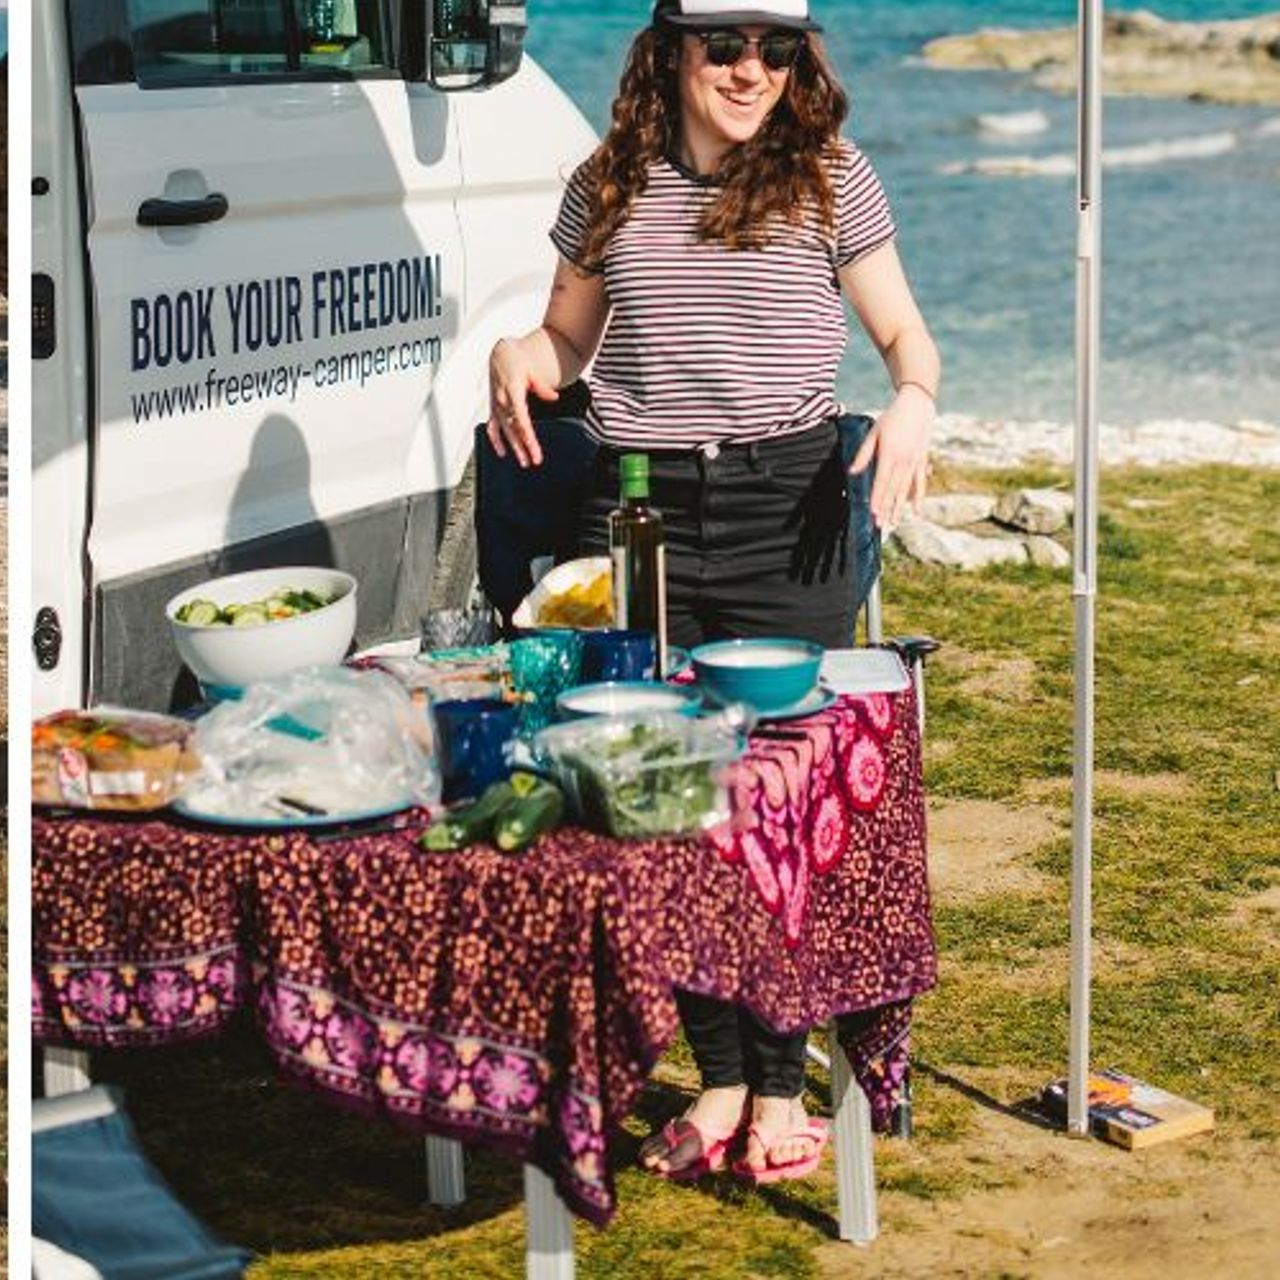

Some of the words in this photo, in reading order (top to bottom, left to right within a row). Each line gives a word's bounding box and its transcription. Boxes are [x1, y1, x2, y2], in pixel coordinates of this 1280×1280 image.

[130, 286, 216, 371] BOOK
[226, 276, 303, 355] YOUR
[312, 254, 442, 339] FREEDOM!
[131, 334, 442, 424] www.freeway-camper.com
